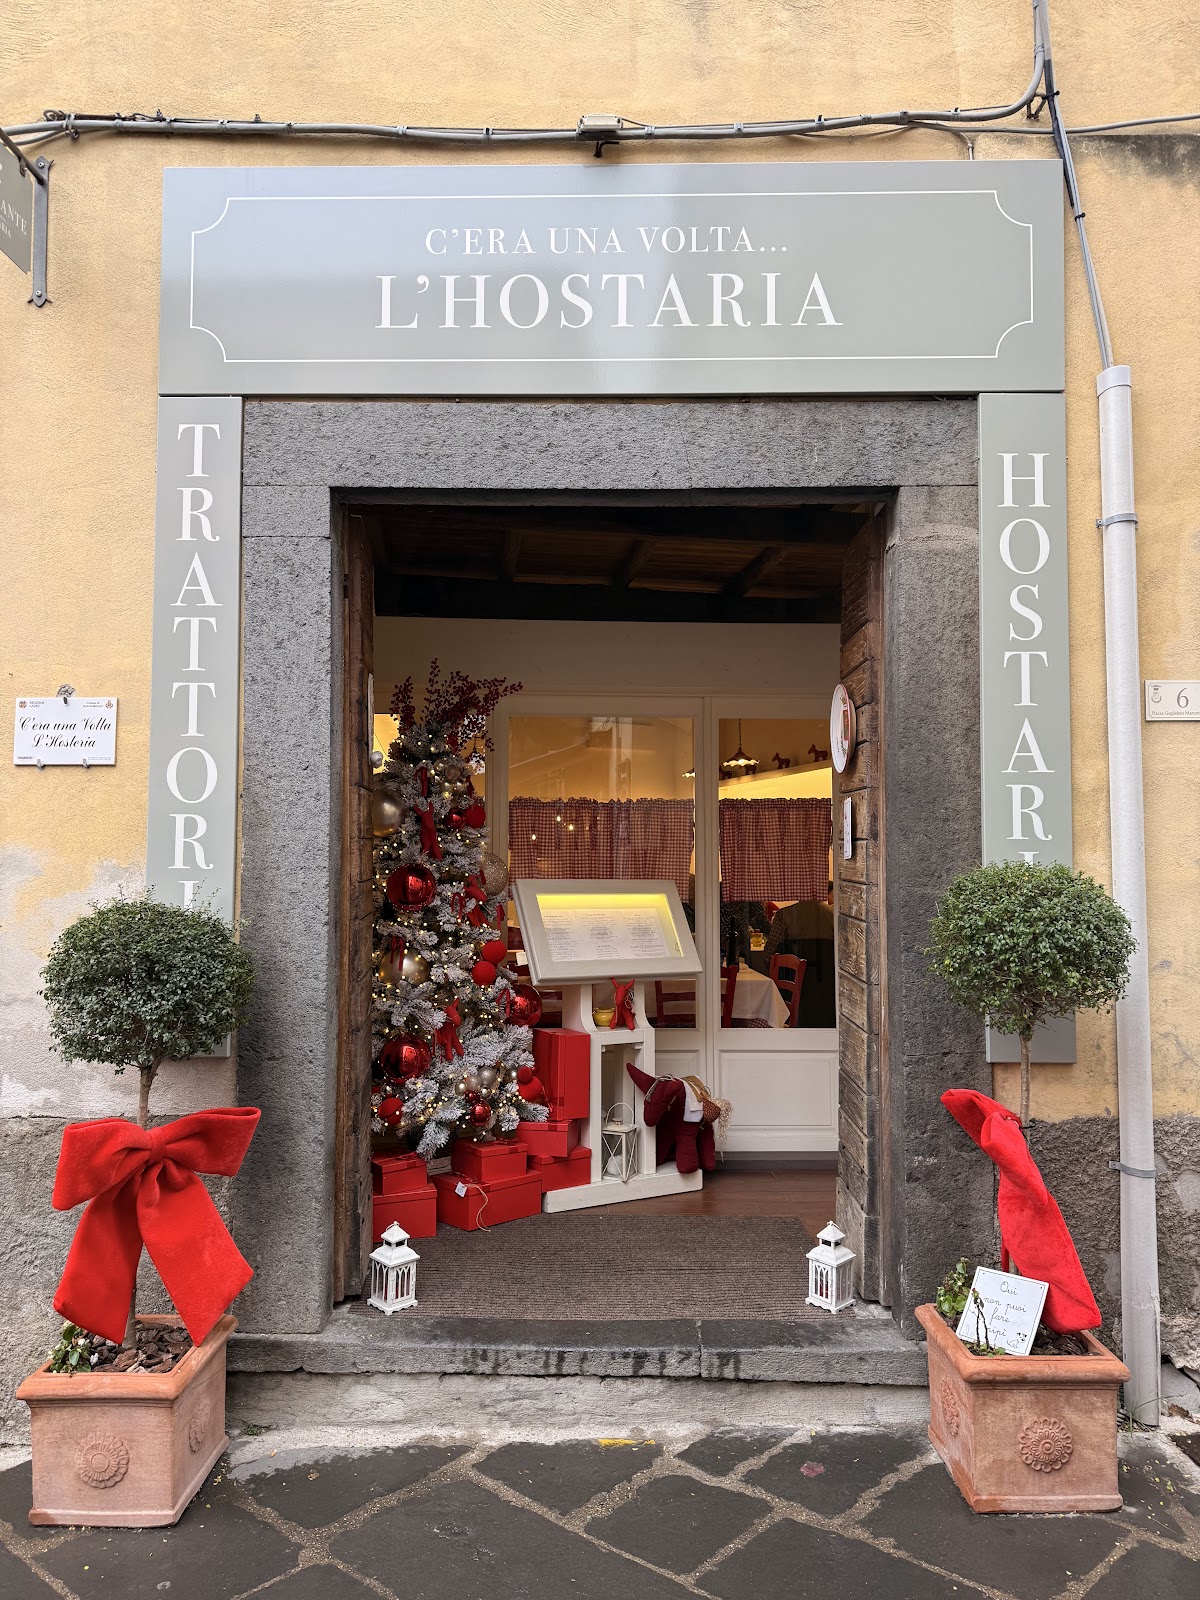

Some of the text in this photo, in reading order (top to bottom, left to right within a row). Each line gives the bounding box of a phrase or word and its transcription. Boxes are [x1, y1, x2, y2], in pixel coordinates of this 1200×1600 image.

[425, 226, 788, 255] C'ERA UNA VOLTA...
[374, 271, 844, 329] L'HOSTARIA
[166, 423, 223, 912] TRATTORI
[996, 452, 1056, 868] HOSTAR
[1176, 687, 1189, 708] 6
[19, 716, 112, 731] C'era una Volta
[984, 1297, 1027, 1316] non puoi
